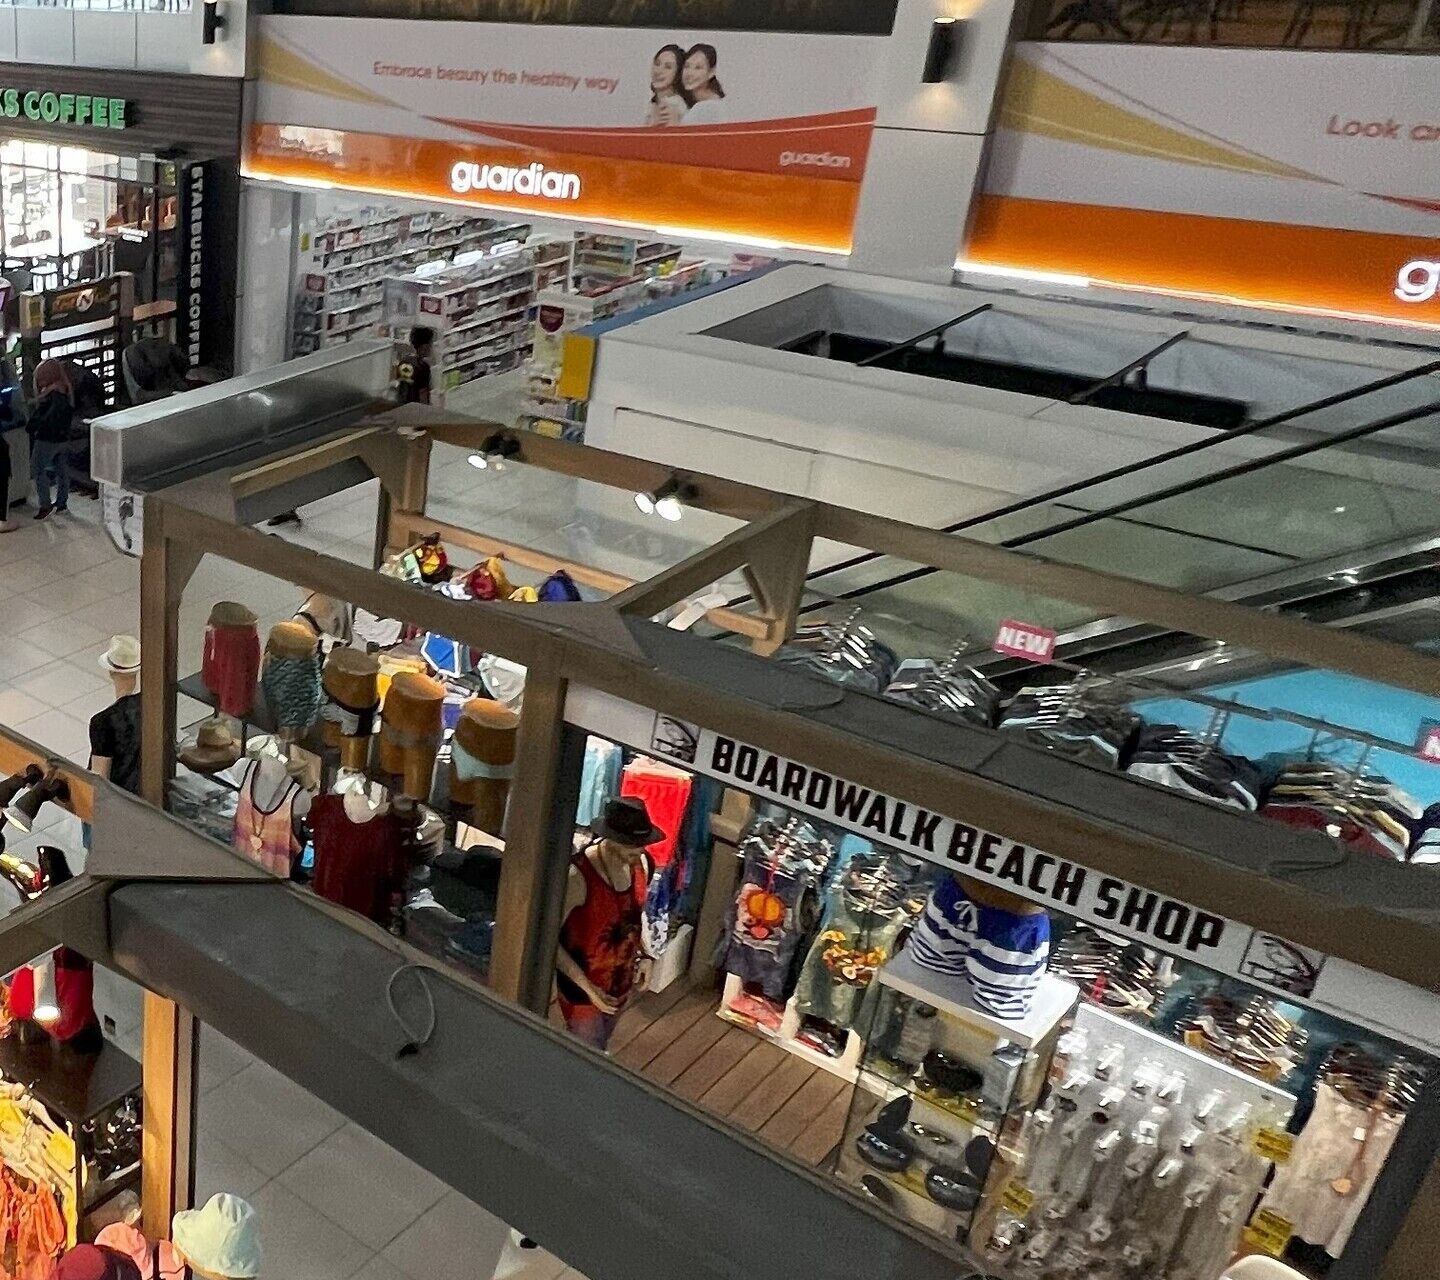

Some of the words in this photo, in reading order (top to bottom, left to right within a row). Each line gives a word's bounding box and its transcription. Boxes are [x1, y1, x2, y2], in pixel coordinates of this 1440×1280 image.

[373, 61, 433, 79] Embrace
[436, 63, 489, 85] beauty
[492, 68, 516, 84] the
[520, 70, 581, 93] healthy
[584, 76, 620, 95] way
[23, 90, 126, 130] COFFEE
[1326, 113, 1403, 139] Look
[780, 151, 851, 168] guardian
[450, 161, 582, 201] guardian
[189, 165, 204, 290] STARBUCKS
[187, 292, 202, 366] COFFEE
[998, 627, 1051, 656] NEW
[710, 735, 943, 853] BOARDWALK
[947, 822, 1087, 907] BEACH
[1092, 875, 1226, 953] SHOP
